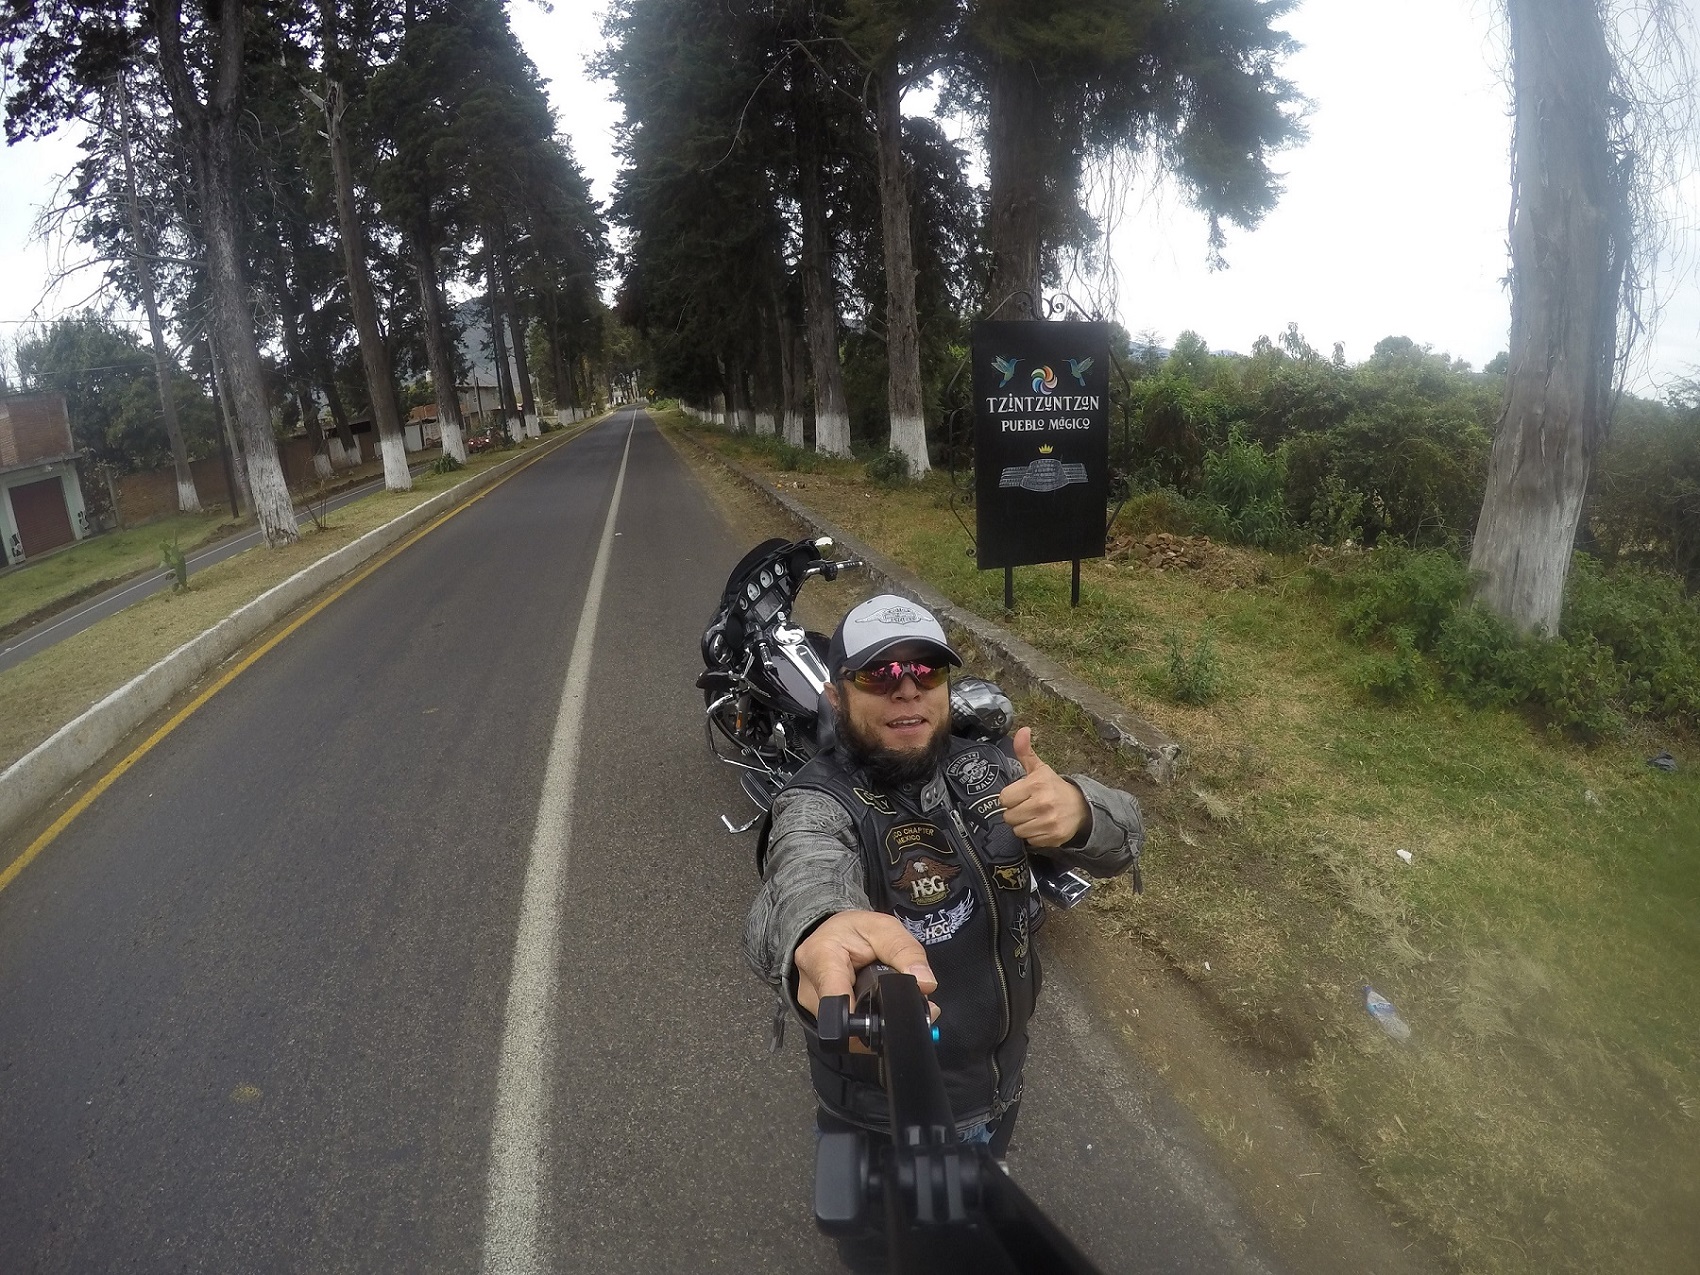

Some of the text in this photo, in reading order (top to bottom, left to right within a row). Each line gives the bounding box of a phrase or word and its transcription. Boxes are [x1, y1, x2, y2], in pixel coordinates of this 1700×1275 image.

[1001, 419, 1044, 432] PUEBLO
[975, 771, 996, 791] RALLY
[896, 834, 921, 845] MEXICO
[910, 875, 946, 898] HOG
[925, 922, 950, 940] HOG
